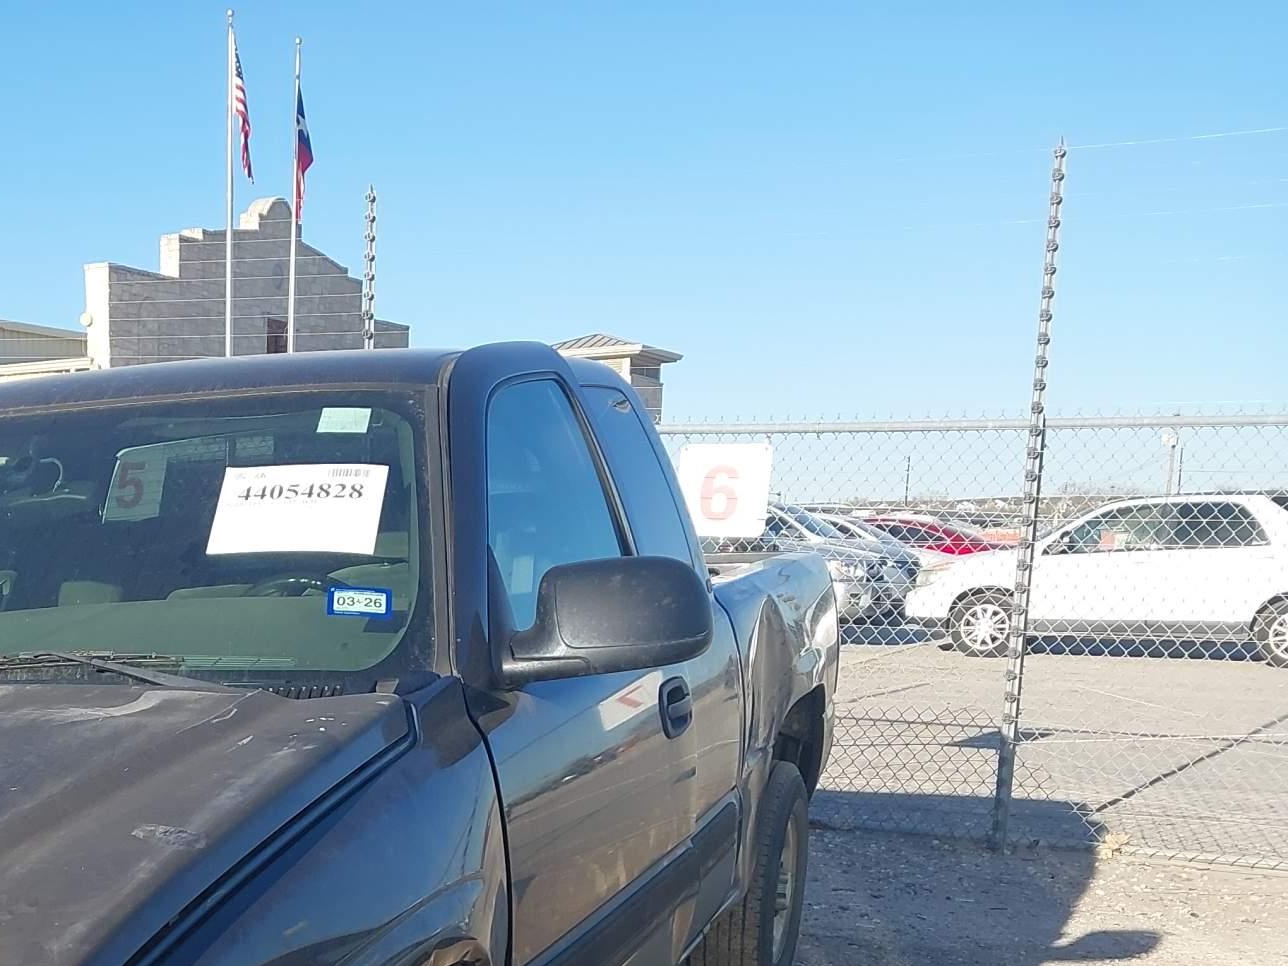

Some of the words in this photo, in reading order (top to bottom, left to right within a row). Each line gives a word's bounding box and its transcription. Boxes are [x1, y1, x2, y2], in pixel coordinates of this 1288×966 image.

[115, 461, 146, 509] 5
[238, 483, 364, 501] 44054828
[700, 464, 739, 520] 6
